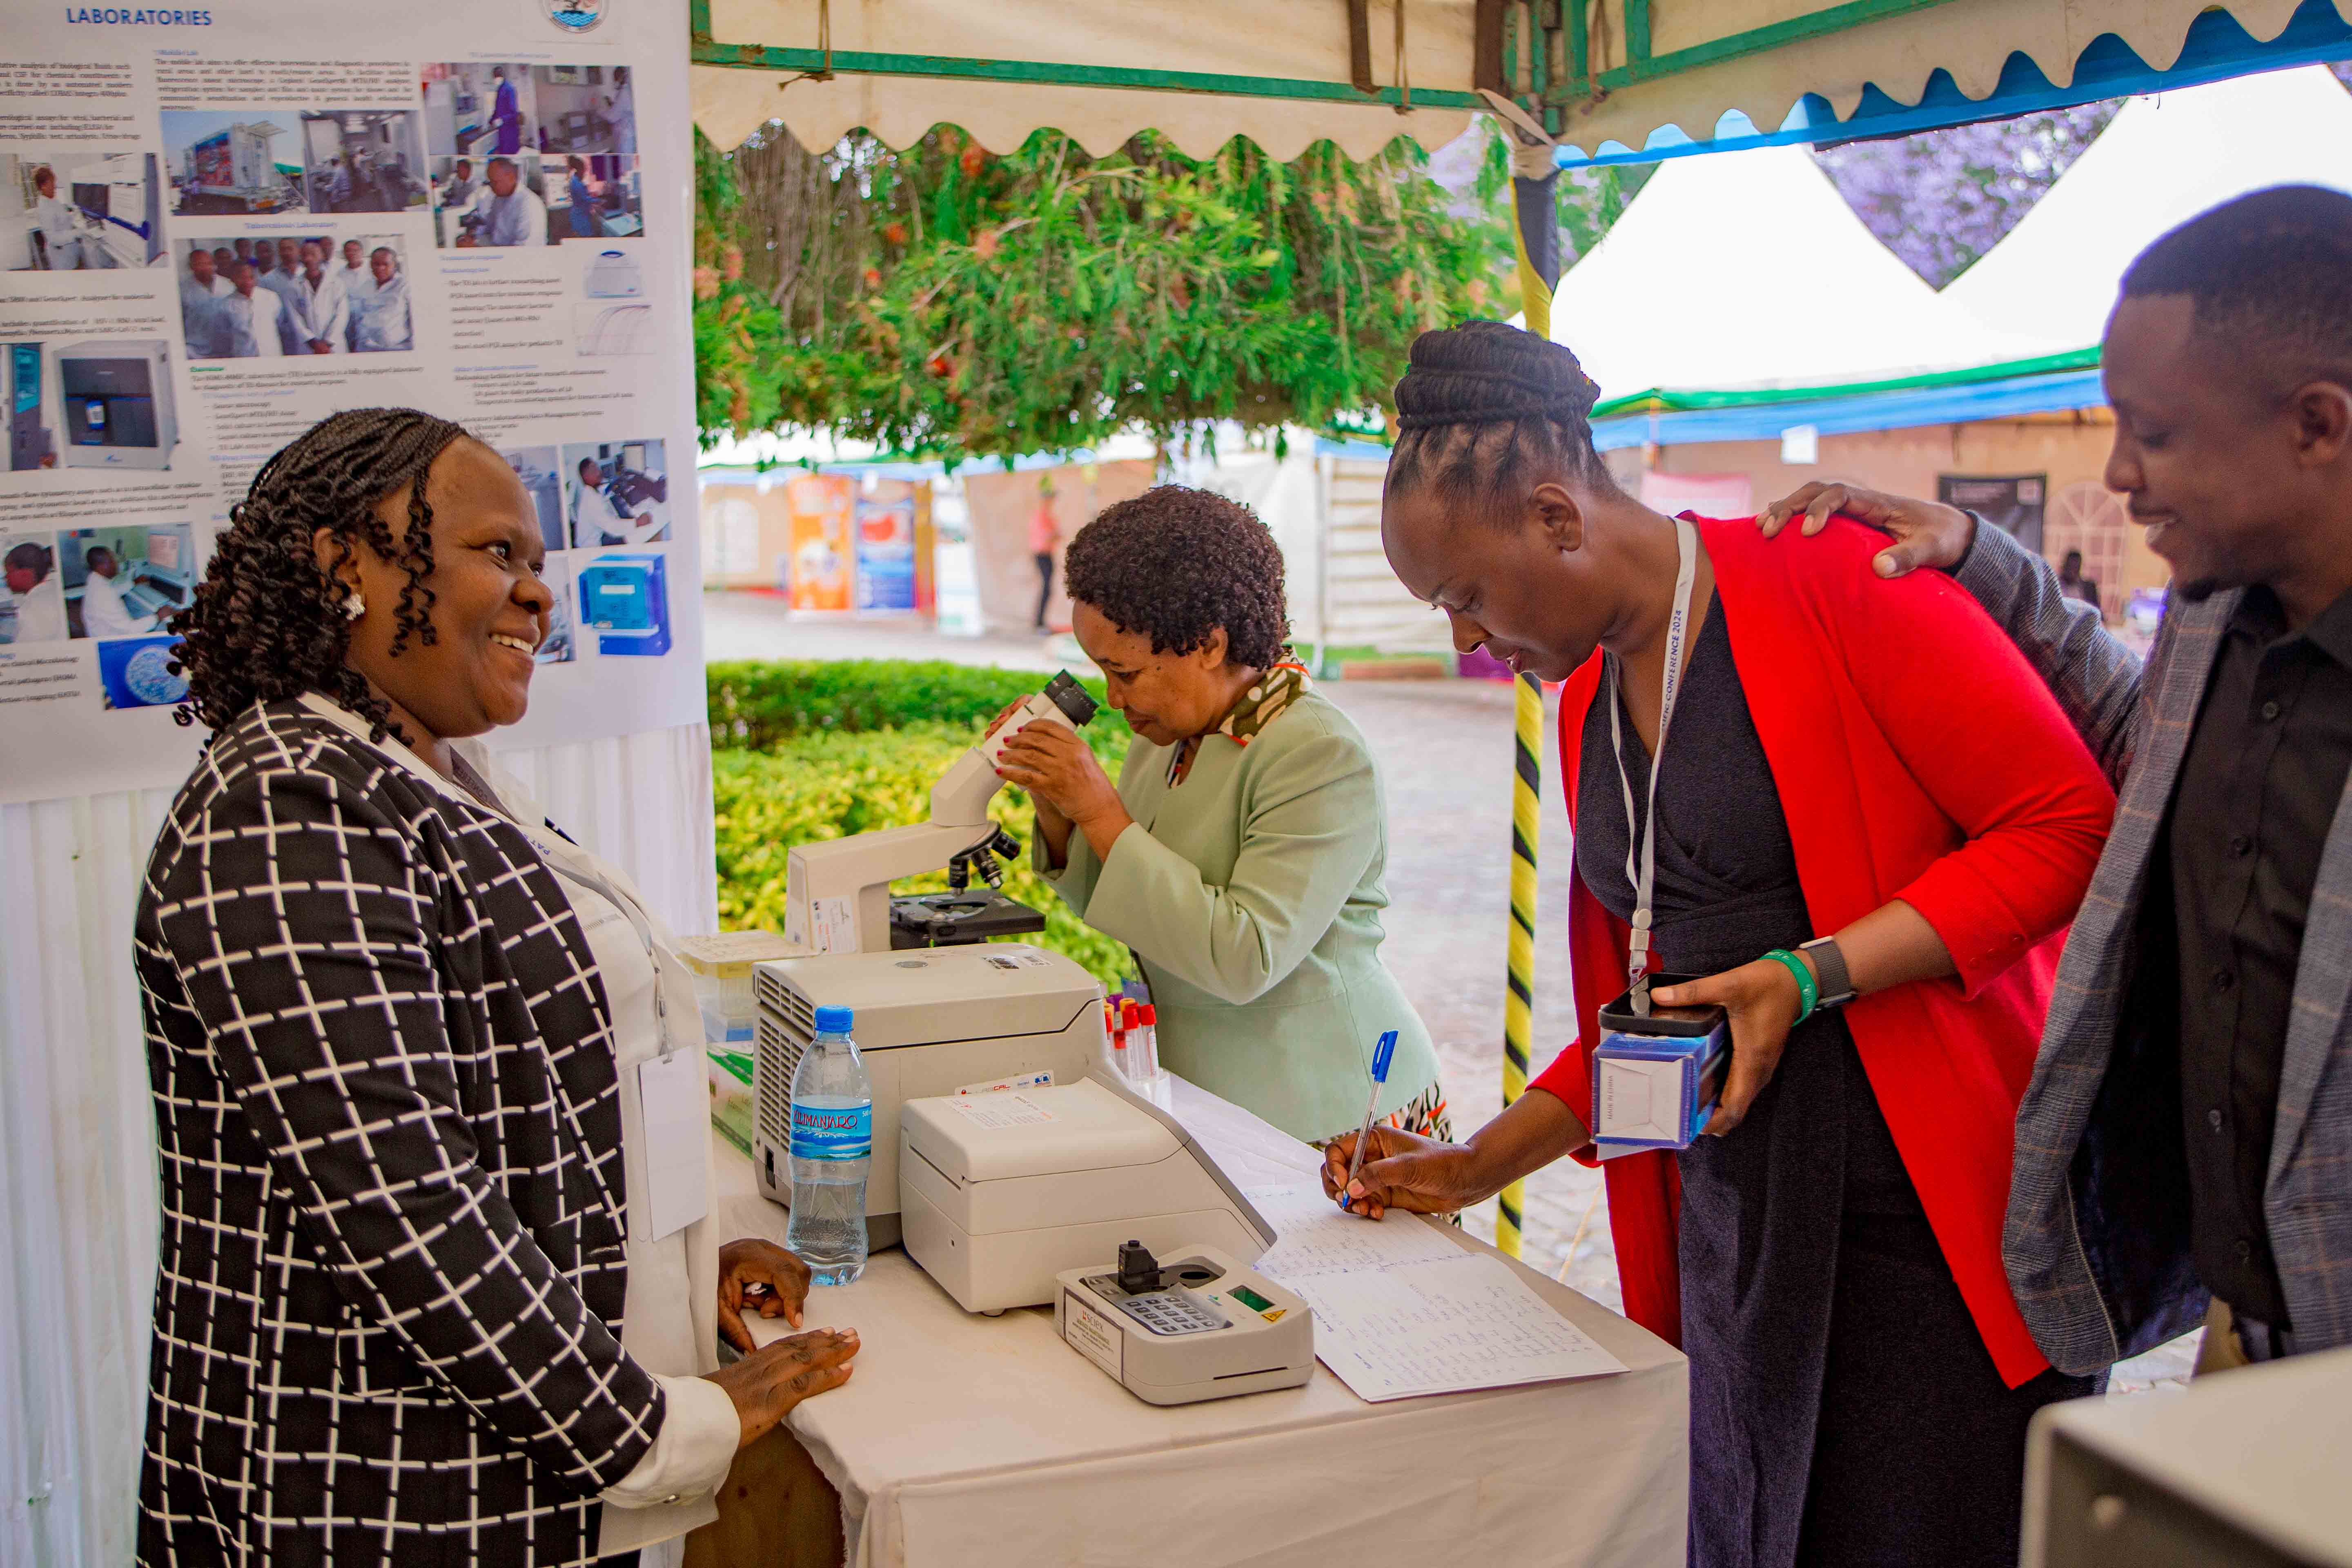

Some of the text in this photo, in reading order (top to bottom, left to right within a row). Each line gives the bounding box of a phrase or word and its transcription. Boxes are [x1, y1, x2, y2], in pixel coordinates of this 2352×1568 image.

[66, 8, 212, 26] LABORATORIES
[1672, 610, 1682, 633] 2024
[1666, 635, 1679, 701] CONFERENCE
[793, 1108, 858, 1129] KILIMANJARO
